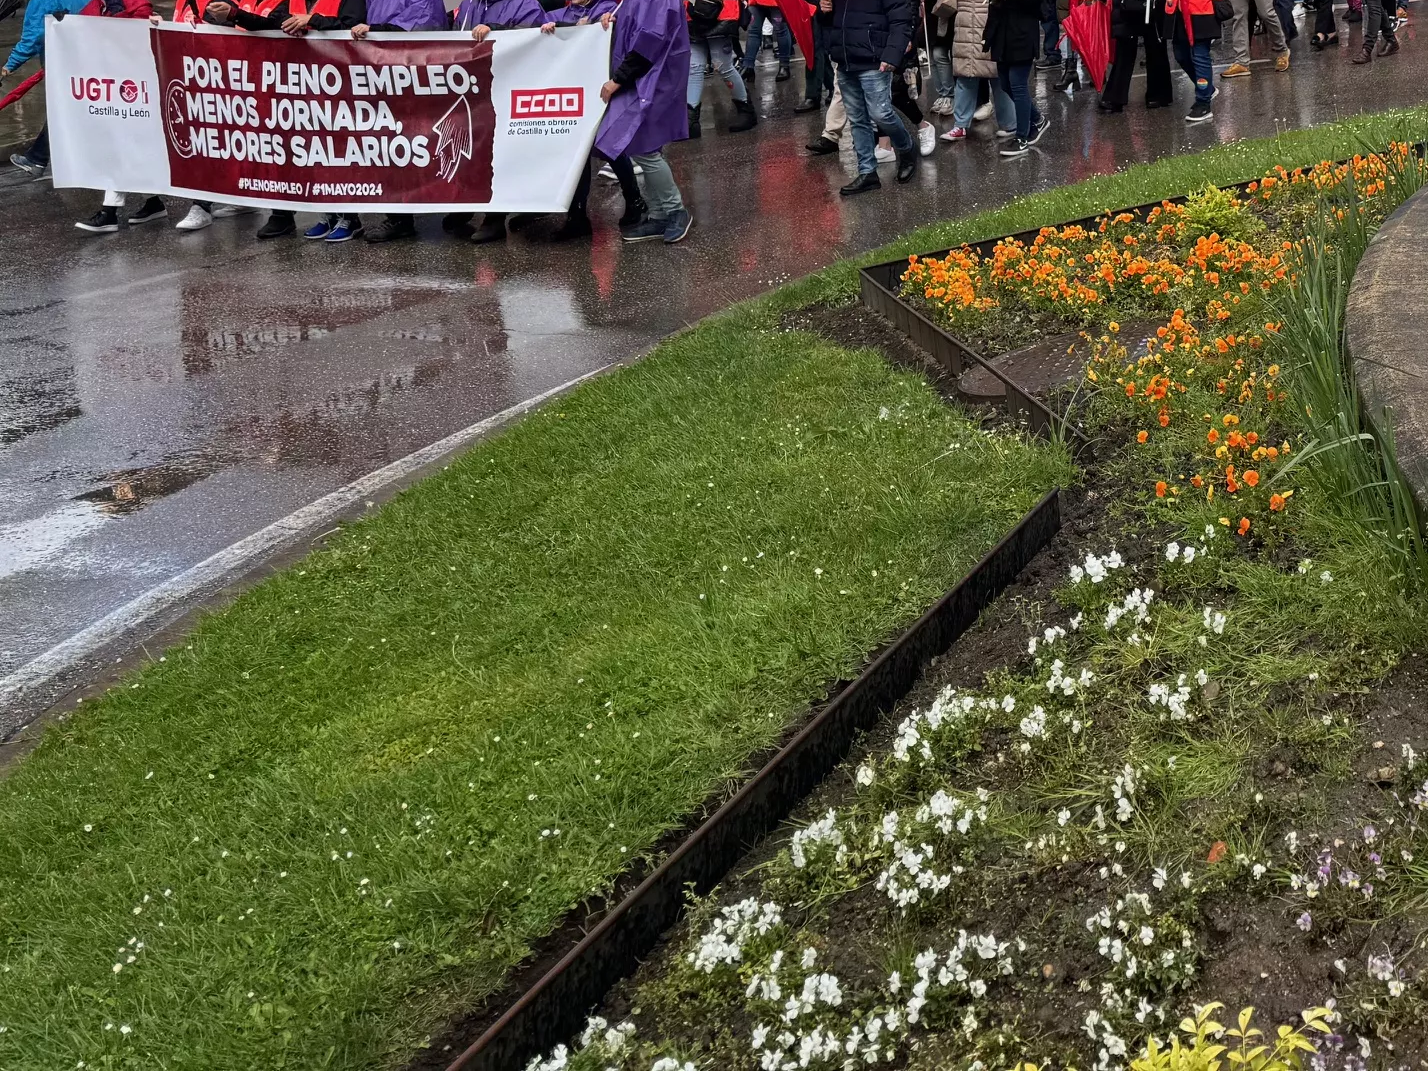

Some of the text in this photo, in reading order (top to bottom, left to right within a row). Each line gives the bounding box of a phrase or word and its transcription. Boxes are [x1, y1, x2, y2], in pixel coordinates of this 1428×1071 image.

[183, 56, 480, 96] POR EL PLENO EMPLEO:
[70, 76, 115, 102] UGT
[88, 105, 150, 119] Castilla y León
[185, 91, 403, 135] MENOS JORNADA,
[515, 93, 579, 113] CCOO
[509, 120, 546, 128] comisiones
[516, 127, 543, 135] Castilla
[190, 127, 431, 168] MEJORES SALARIOS
[238, 178, 303, 195] #PLENOEMPLEO
[312, 183, 383, 196] #1MAYO2024
